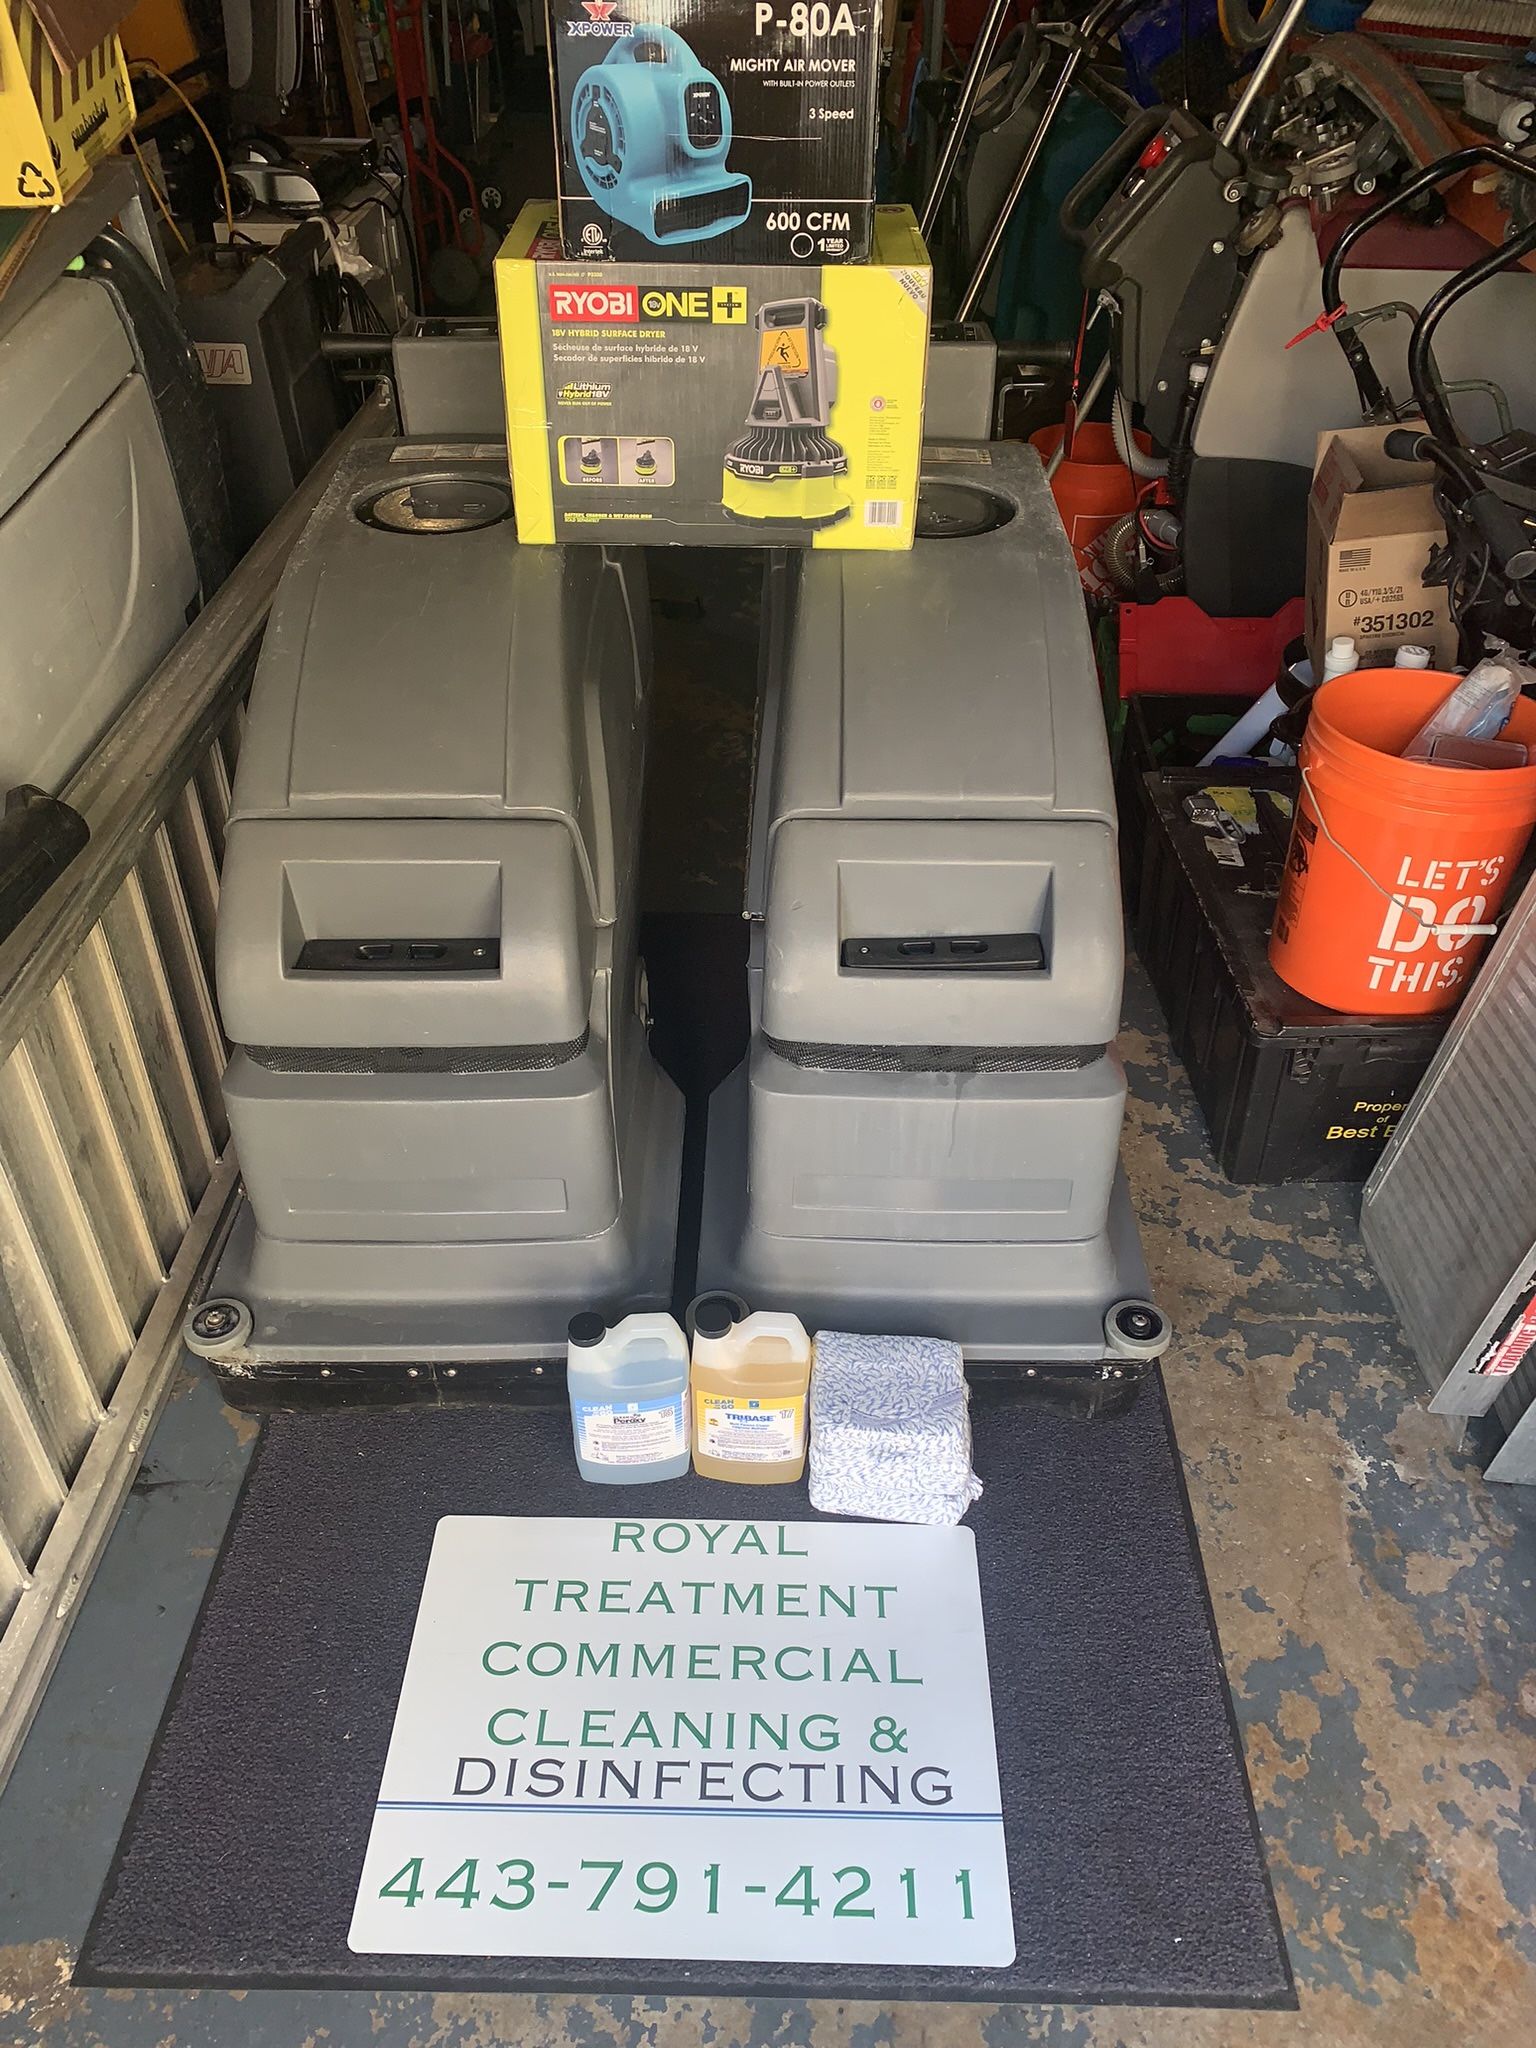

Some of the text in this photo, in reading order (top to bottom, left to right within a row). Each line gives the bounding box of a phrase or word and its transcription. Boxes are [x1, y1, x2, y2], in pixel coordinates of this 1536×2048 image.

[755, 2, 856, 36] P-80A
[567, 21, 634, 37] XPOWER
[730, 59, 856, 72] MIGHTY AIR MOVER
[805, 80, 828, 88] POWER
[829, 80, 855, 88] OUTLETS
[809, 108, 854, 121] 3 Speed
[766, 212, 850, 231] 600 CFM
[817, 238, 825, 251] 1
[899, 278, 919, 300] NUEVO
[554, 291, 633, 315] RYOBI
[552, 329, 666, 338] 18V HYBRID SURFACE DRYER
[592, 343, 602, 351] de
[604, 344, 633, 352] surface
[635, 345, 666, 353] hybride
[668, 345, 679, 353] de
[681, 345, 690, 353] 18
[692, 345, 699, 353] V
[553, 354, 585, 362] Secador
[587, 354, 598, 362] de
[600, 355, 642, 364] superficies
[573, 382, 611, 391] Lithium
[740, 463, 764, 475] RYOBI
[1353, 610, 1434, 633] #351302
[1397, 855, 1504, 891] LET'S
[1377, 893, 1486, 953] DO
[1354, 1101, 1408, 1113] Proper
[1376, 1115, 1391, 1123] of
[1326, 1125, 1378, 1140] Best
[582, 1404, 612, 1412] CLEAN
[614, 1417, 646, 1425] Peroxy
[725, 1413, 775, 1422] TRIBASE
[612, 1522, 809, 1557] ROYAL
[515, 1579, 898, 1619] TREATMENT
[482, 1641, 924, 1686] COMMERCIAL
[487, 1708, 909, 1753] CLEANING &
[453, 1757, 954, 1806] DISINFECTING
[380, 1857, 976, 1920] 443-791-4211
